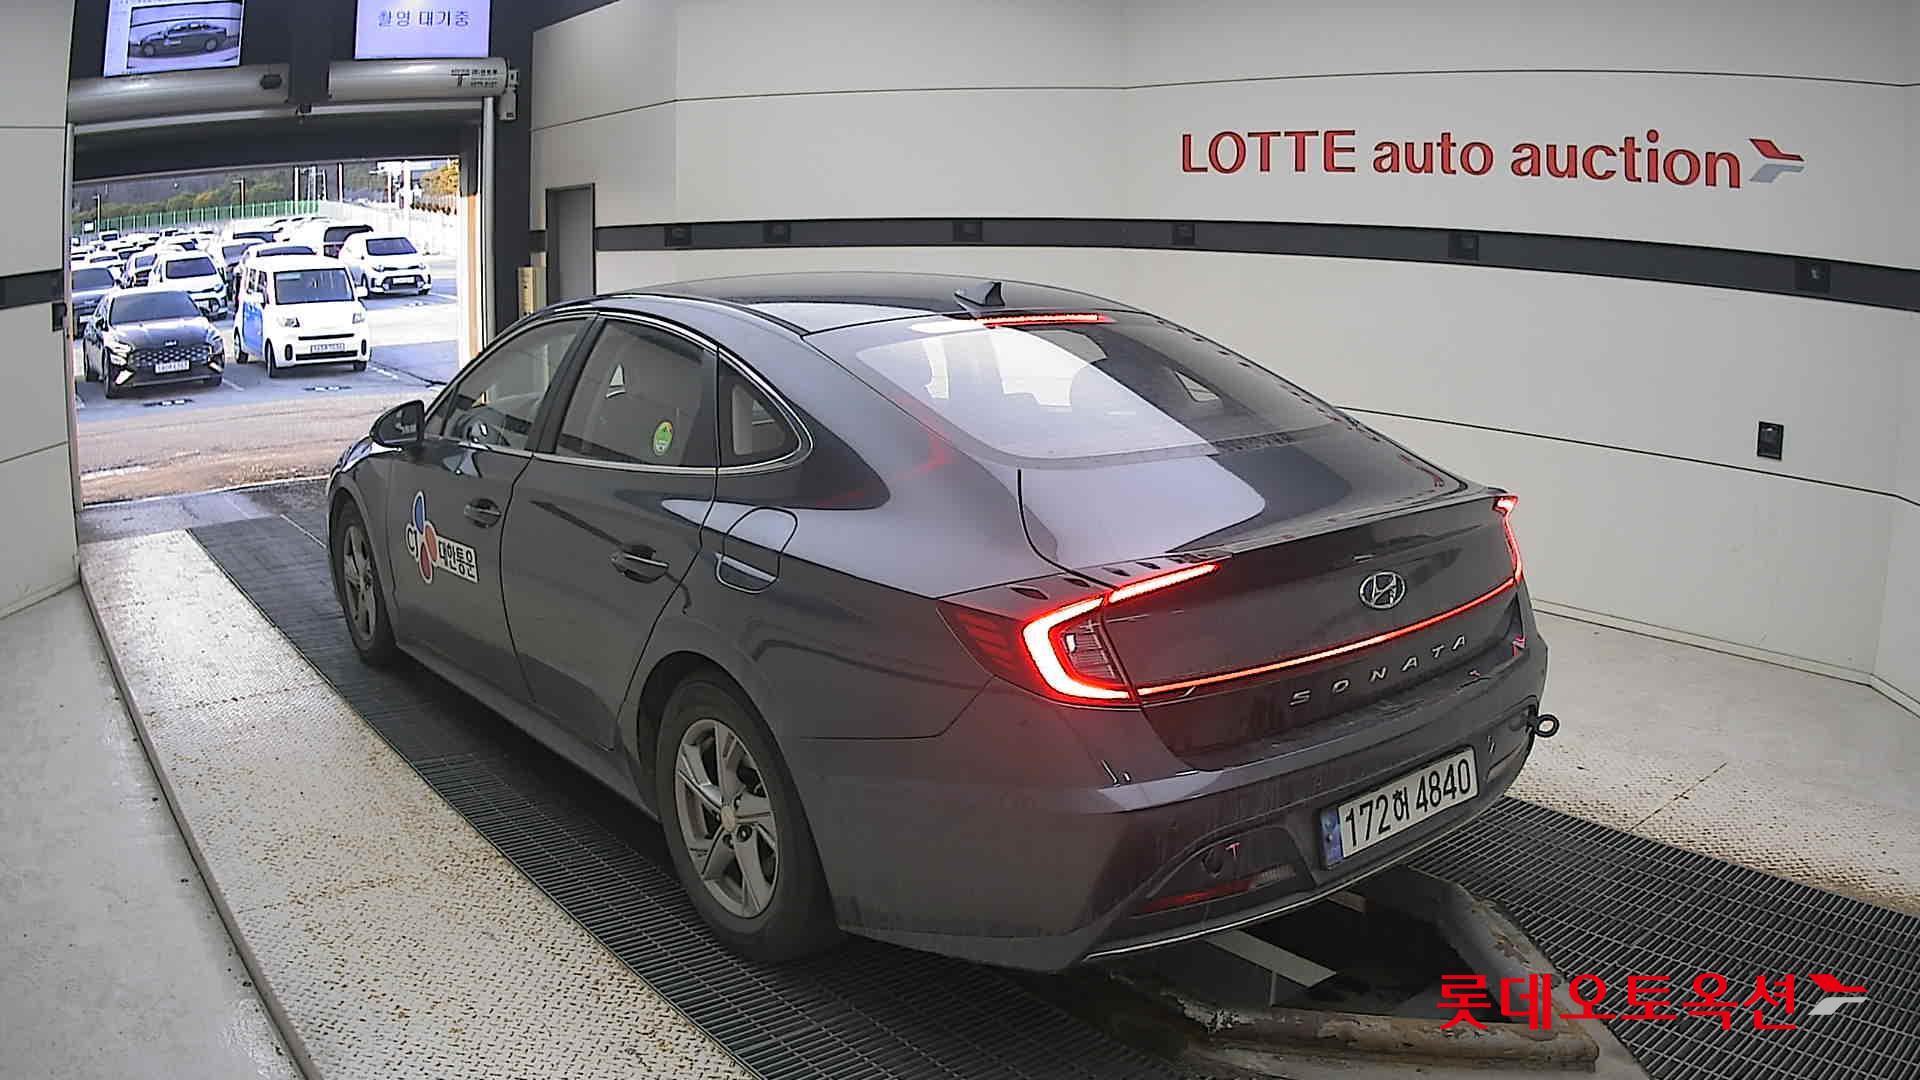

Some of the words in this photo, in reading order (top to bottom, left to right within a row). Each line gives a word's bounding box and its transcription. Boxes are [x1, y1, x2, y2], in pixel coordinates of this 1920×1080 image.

[418, 8, 471, 27] 대기중
[1181, 130, 1357, 174] LOTTE
[1372, 131, 1495, 177] auto
[1510, 129, 1742, 189] auction
[1288, 634, 1469, 708] SONATA
[1344, 786, 1411, 848] 172허
[1415, 757, 1472, 813] 4840
